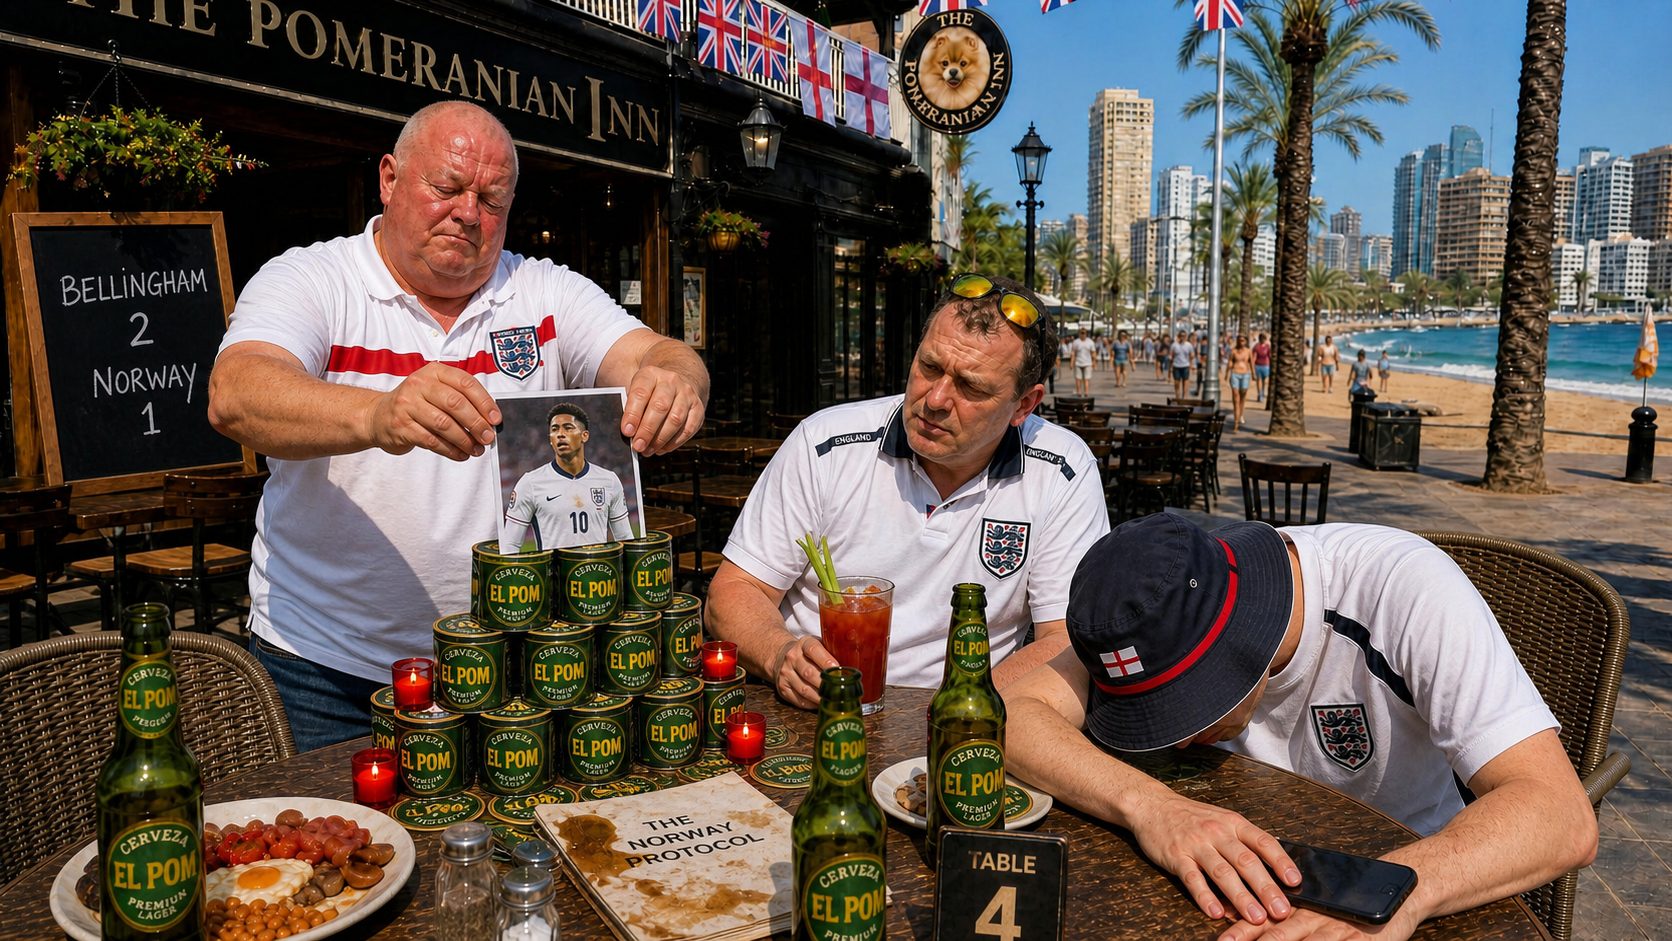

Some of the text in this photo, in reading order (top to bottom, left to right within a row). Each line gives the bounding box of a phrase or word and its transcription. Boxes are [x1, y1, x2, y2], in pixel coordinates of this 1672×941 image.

[937, 11, 974, 27] THE
[247, 0, 660, 146] POMERANIAN INN
[991, 52, 1005, 90] INN
[129, 311, 154, 347] 2
[93, 362, 197, 404] NORWAY
[141, 401, 161, 436] 1
[834, 433, 872, 445] ENGLAND
[569, 511, 589, 534] 10
[495, 568, 536, 581] CERVEZA
[637, 570, 653, 587] EL
[490, 583, 540, 604] EL POM
[570, 578, 616, 599] EL POM
[445, 648, 484, 663] CERVEZA
[539, 646, 580, 660] CERVEZA
[675, 637, 689, 654] EL
[953, 639, 967, 656] EL
[610, 649, 655, 670] EL POM
[127, 667, 171, 686] CERVEZA
[441, 663, 490, 686] EL POM
[534, 661, 584, 683] EL POM
[123, 688, 142, 710] EL
[655, 708, 693, 722] CERVEZA
[404, 734, 444, 749] CERVEZA
[491, 732, 533, 745] CERVEZA
[651, 720, 697, 743] EL POM
[572, 735, 622, 758] EL POM
[821, 739, 838, 761] EL
[951, 747, 1001, 767] CERVEZA
[401, 748, 451, 772] EL POM
[487, 747, 538, 769] EL POM
[944, 766, 1004, 797] EL POM
[955, 798, 998, 814] PREMIUM
[642, 815, 694, 832] THE
[120, 829, 189, 855] CERVEZA
[626, 821, 733, 851] NORWAY
[624, 833, 765, 868] PROTOCOL
[113, 849, 197, 890] EL POM
[968, 850, 1037, 875] TABLE
[819, 864, 880, 888] CERVEZA
[137, 905, 177, 920] LAGER
[811, 884, 884, 924] EL POM
[975, 886, 1022, 941] 4
